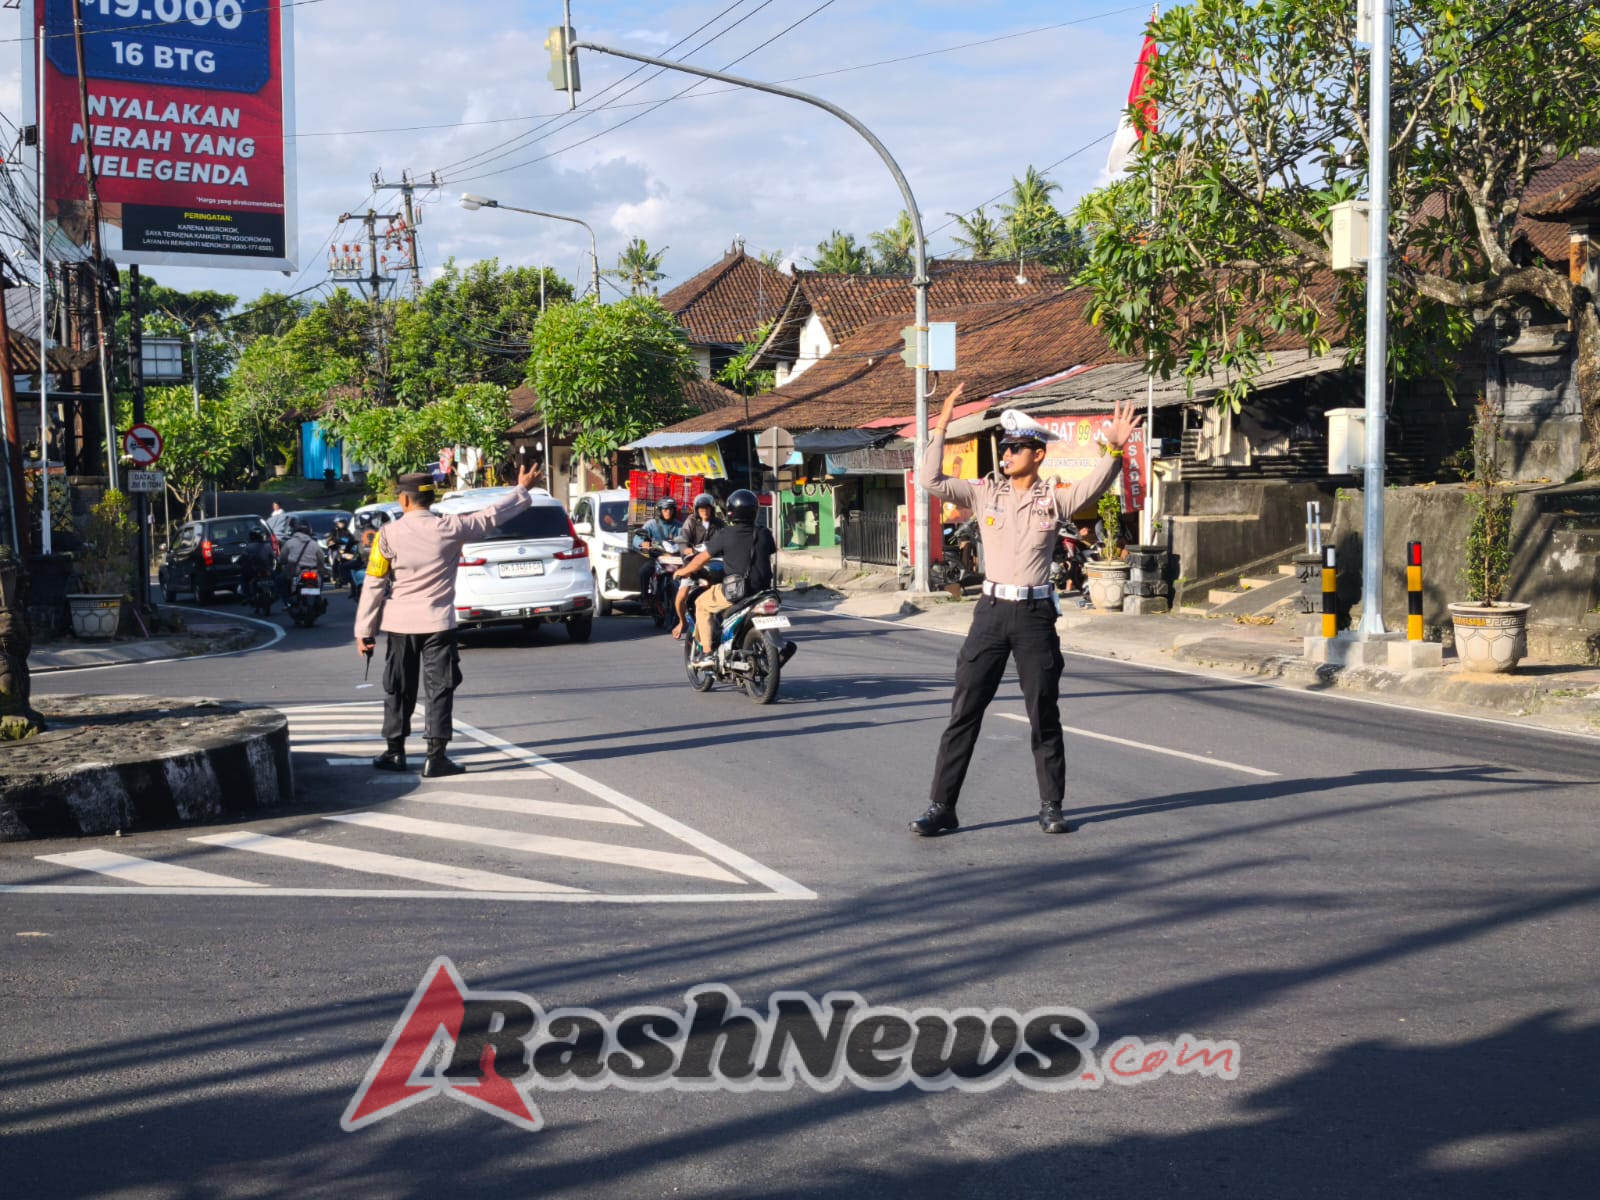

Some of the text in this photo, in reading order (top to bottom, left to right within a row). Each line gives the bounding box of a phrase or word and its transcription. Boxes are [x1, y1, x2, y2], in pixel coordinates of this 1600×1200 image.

[112, 41, 216, 73] 16 BTG
[87, 95, 241, 129] NYALAKAN
[71, 123, 256, 159] MERAH YANG
[78, 154, 249, 187] MELEGENDA
[184, 212, 233, 222] PERINGATAN:
[163, 231, 193, 239] TERKENA
